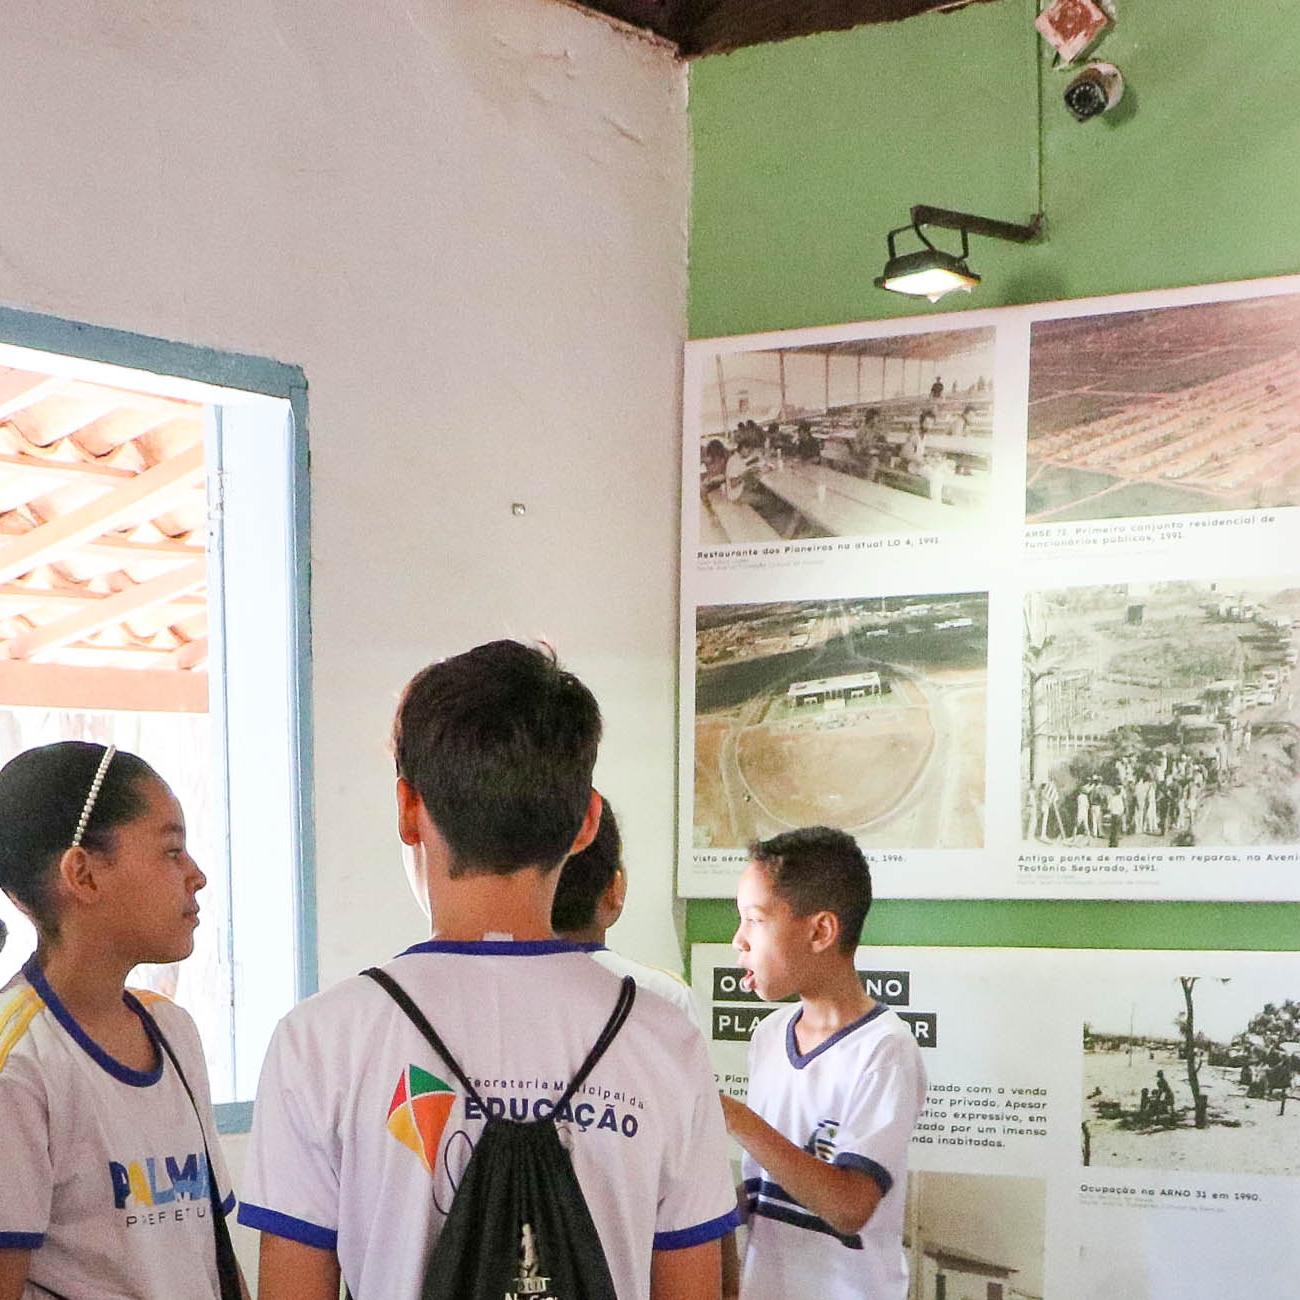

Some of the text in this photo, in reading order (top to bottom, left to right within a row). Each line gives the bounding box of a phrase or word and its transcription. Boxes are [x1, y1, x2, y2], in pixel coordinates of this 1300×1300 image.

[1189, 516, 1255, 528] residencial
[1261, 515, 1275, 523] de
[697, 550, 758, 559] Restaurante
[762, 547, 780, 556] dos
[1060, 855, 1092, 863] ponte
[966, 1084, 991, 1094] com
[1012, 1087, 1047, 1096] venda
[630, 1097, 644, 1110] da
[950, 1097, 1048, 1110] privado. Apesar
[953, 1111, 1023, 1123] expressivo,
[951, 1125, 971, 1133] por
[1003, 1126, 1047, 1136] imenso
[938, 1136, 1005, 1148] inabitadas.
[1080, 1184, 1136, 1195] Ocupação
[1160, 1189, 1191, 1197] ARNO
